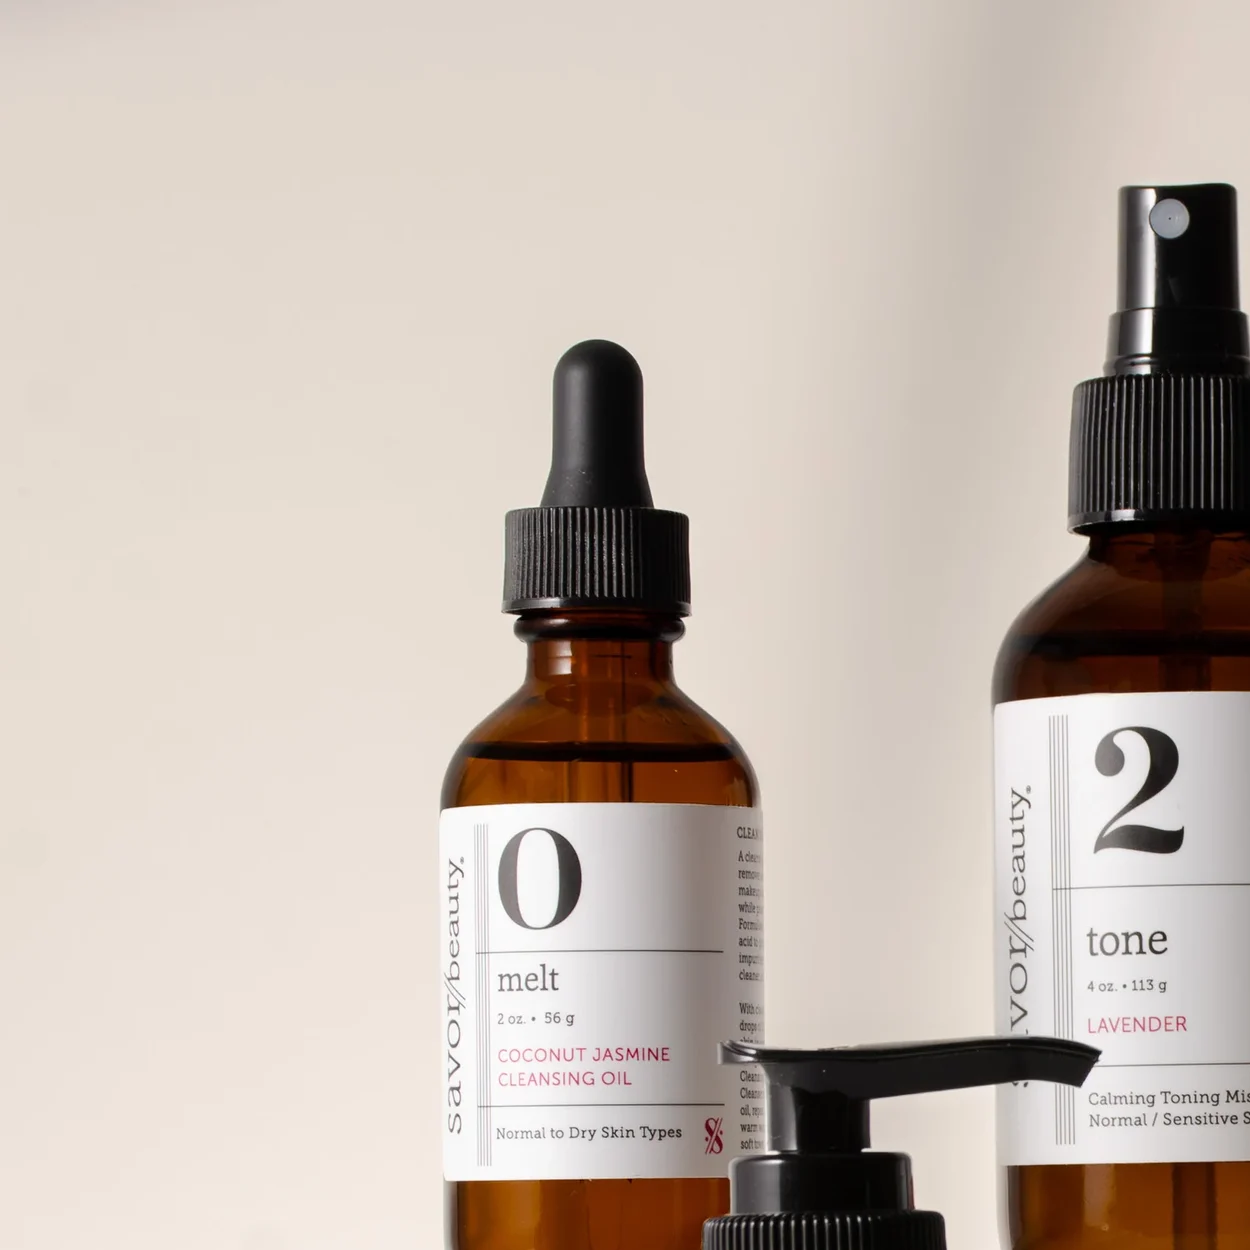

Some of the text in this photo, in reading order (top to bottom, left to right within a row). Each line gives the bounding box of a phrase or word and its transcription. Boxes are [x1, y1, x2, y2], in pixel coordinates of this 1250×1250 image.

[1094, 726, 1184, 854] 2
[498, 828, 582, 930] 0
[1086, 928, 1168, 956] tone
[497, 964, 559, 992] melt
[1087, 981, 1096, 992] 4
[1131, 979, 1156, 991] 113
[1158, 982, 1168, 994] g
[740, 1003, 754, 1014] With
[497, 1013, 504, 1025] 2
[544, 1012, 561, 1024] 56
[565, 1014, 574, 1026] g
[1087, 1016, 1187, 1034] LAVENDER
[498, 1046, 670, 1063] COCONUT JASMINE
[498, 1071, 632, 1087] CLEANSING OIL
[1088, 1090, 1156, 1108] Calming
[1160, 1090, 1220, 1107] Toning
[1090, 1112, 1146, 1126] Normal
[1152, 1112, 1158, 1127] /
[1163, 1111, 1238, 1126] Sensitive
[496, 1125, 682, 1143] Normal to Dry Skin Types
[741, 1140, 753, 1149] soft
